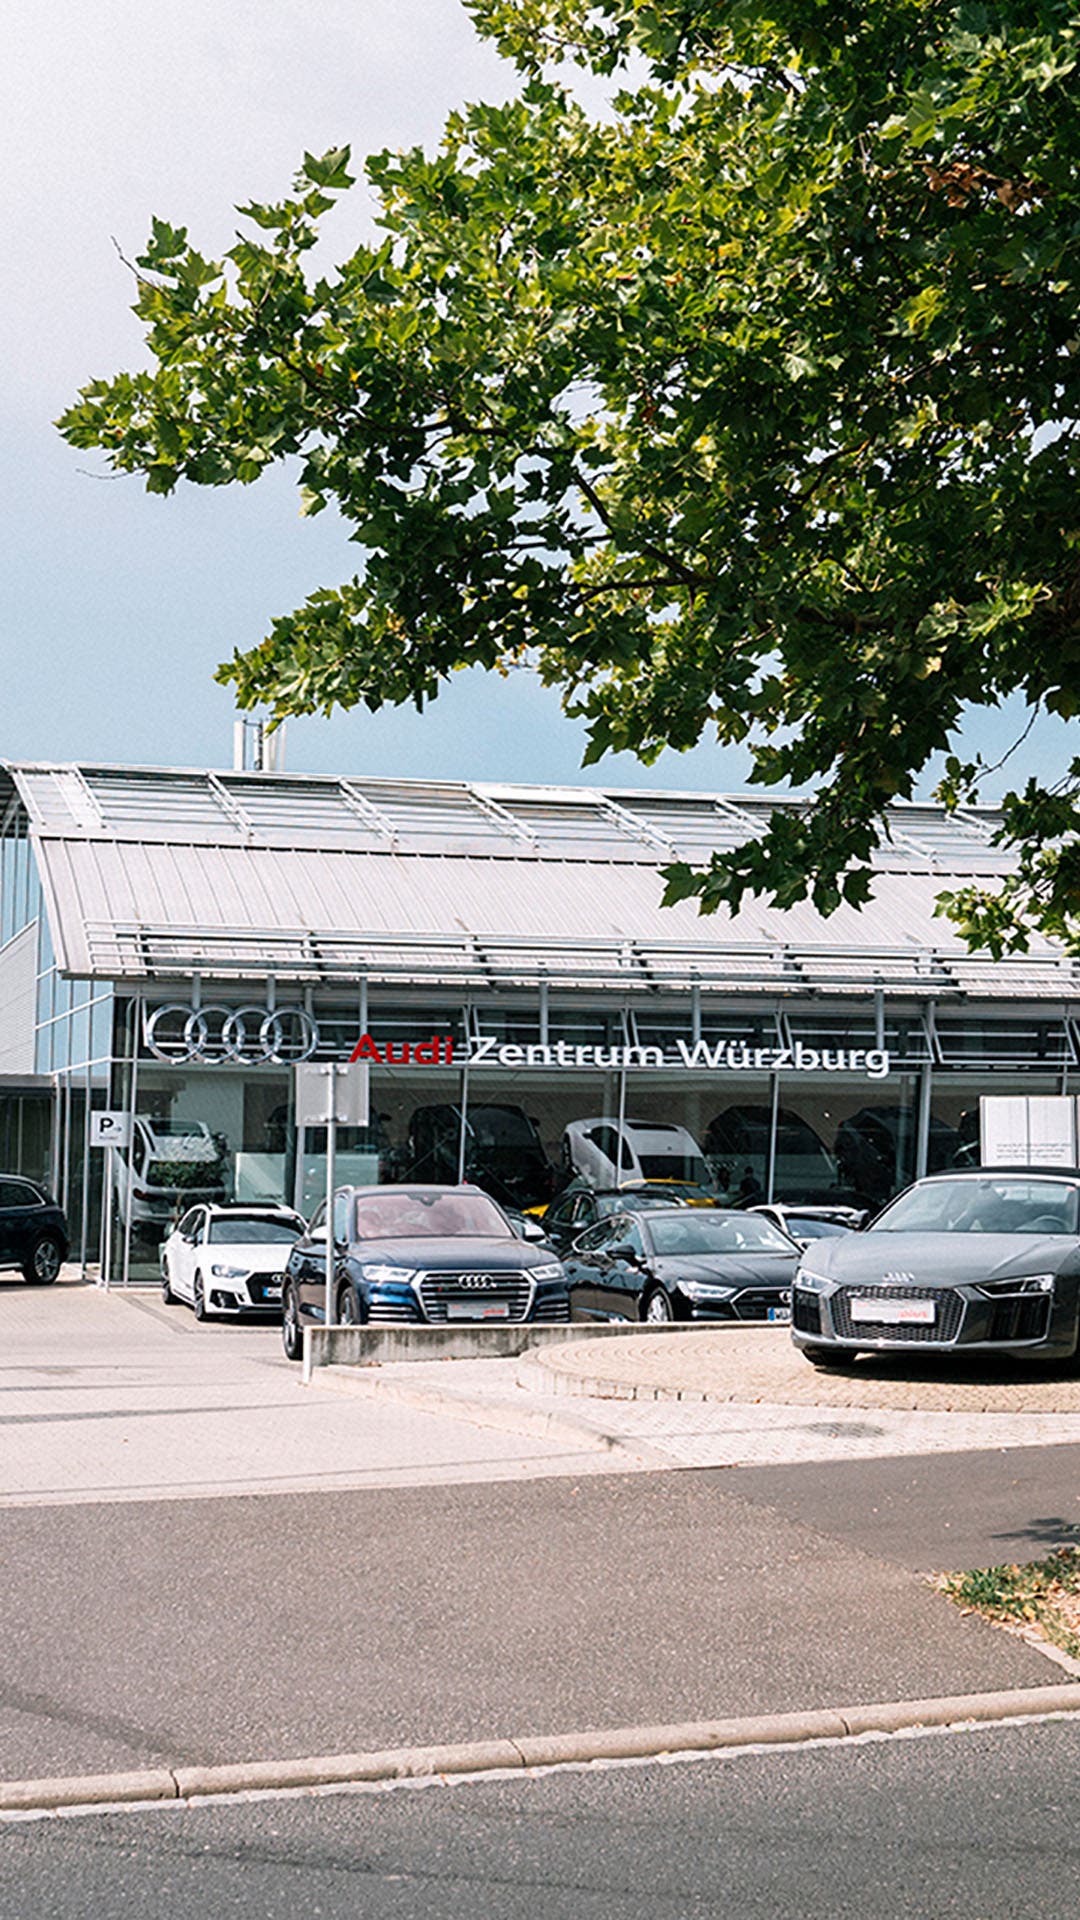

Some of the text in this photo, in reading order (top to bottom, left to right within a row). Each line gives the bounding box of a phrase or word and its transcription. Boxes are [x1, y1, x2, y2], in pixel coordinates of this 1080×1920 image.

[348, 1033, 889, 1078] Audi Zentrum Würzburg
[100, 1117, 114, 1132] P
